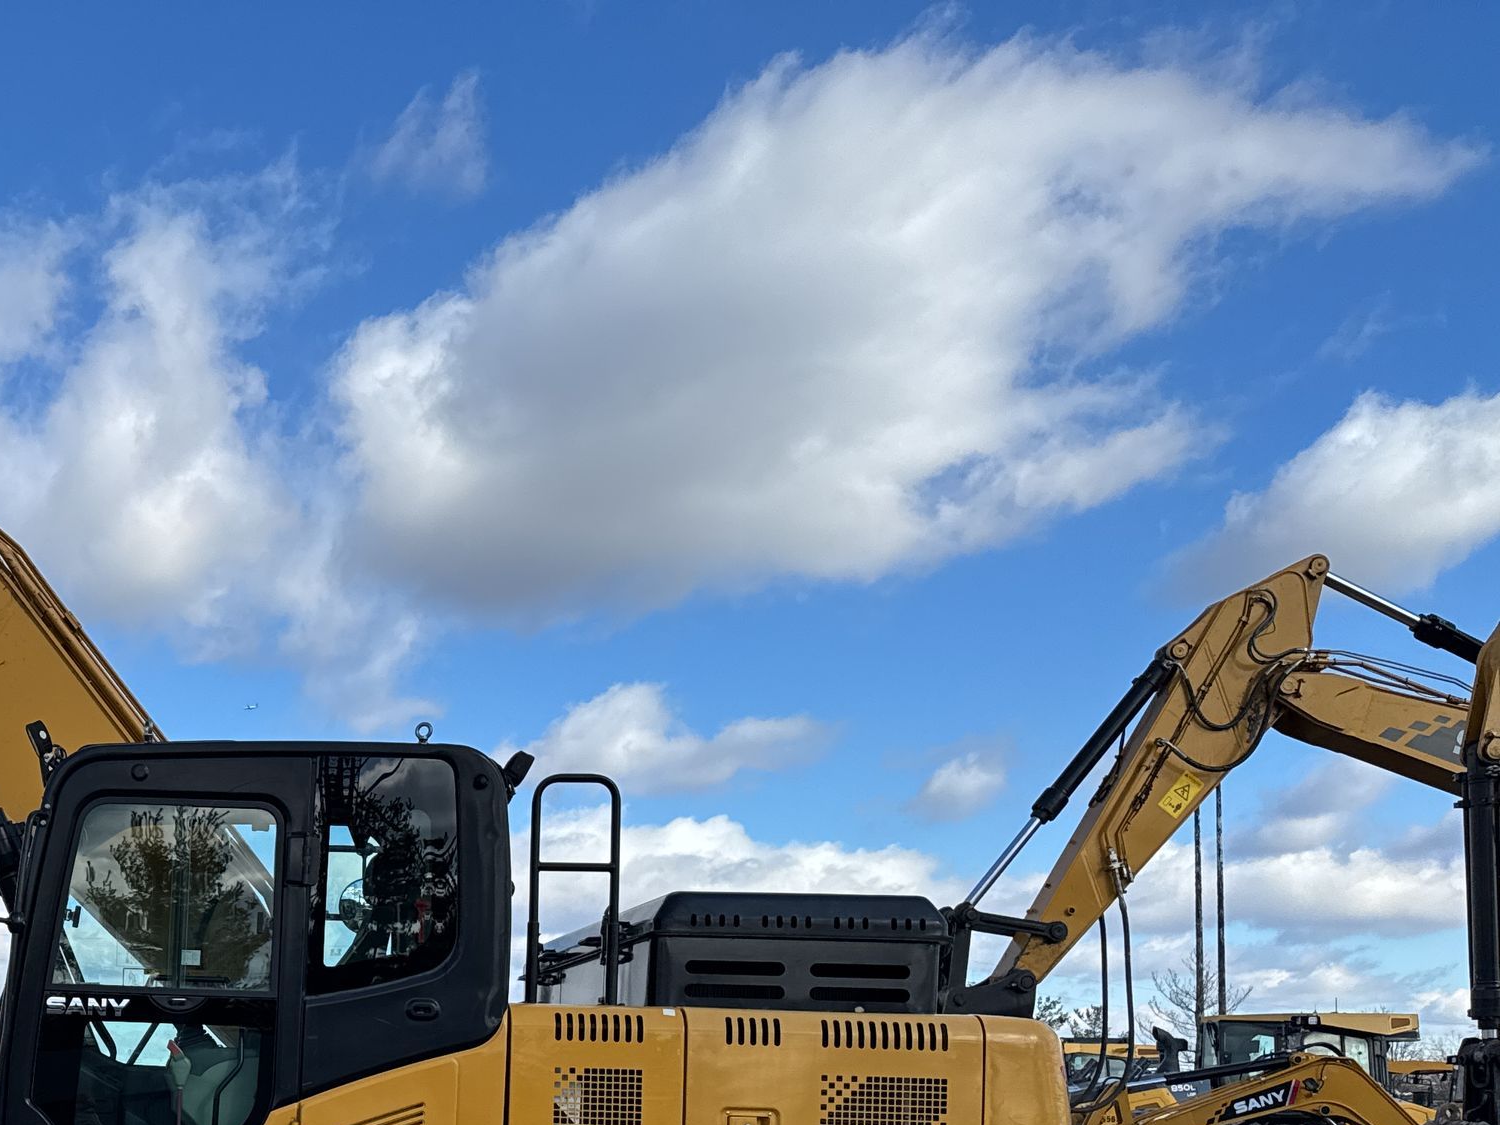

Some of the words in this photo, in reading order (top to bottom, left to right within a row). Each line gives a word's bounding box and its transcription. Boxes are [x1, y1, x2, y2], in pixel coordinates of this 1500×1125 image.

[46, 996, 131, 1017] SANY
[1171, 1084, 1196, 1092] 850L
[1233, 1089, 1285, 1115] SANY
